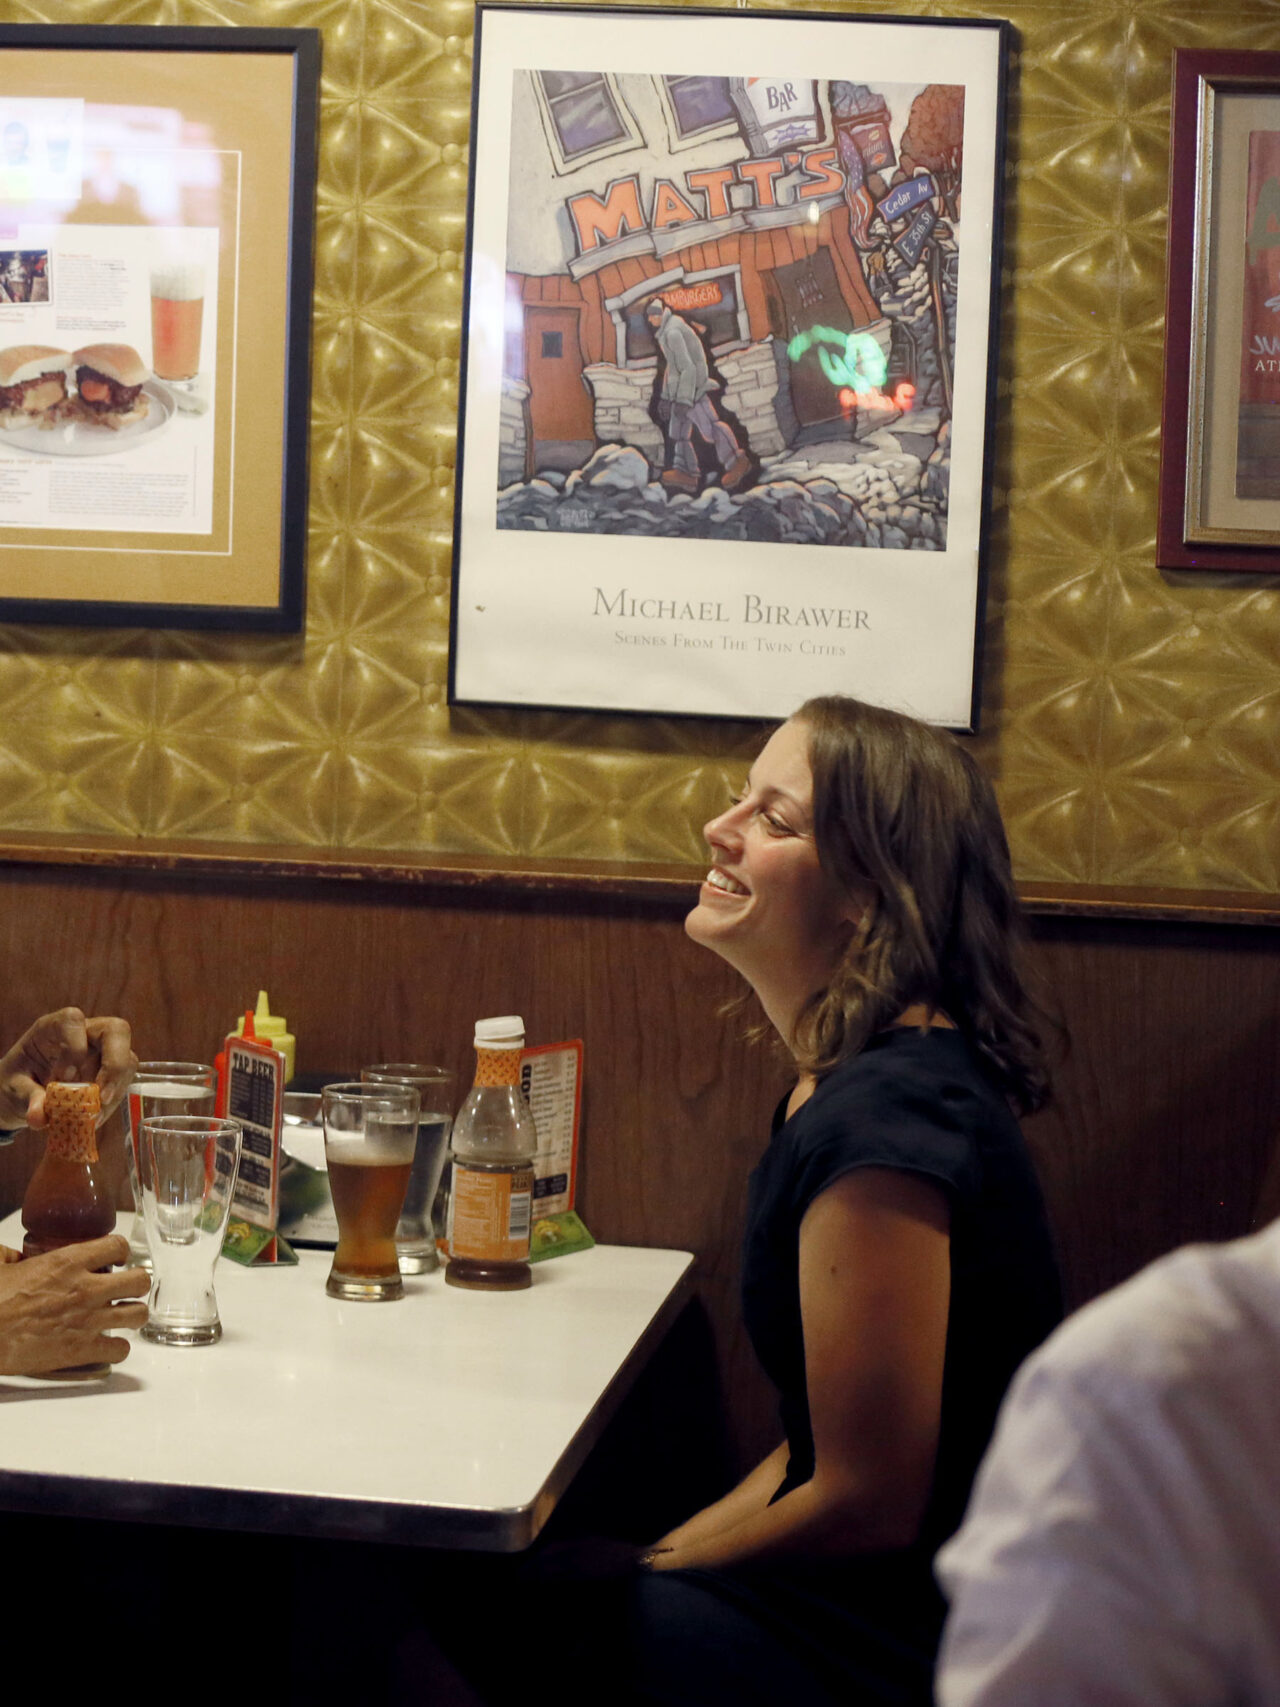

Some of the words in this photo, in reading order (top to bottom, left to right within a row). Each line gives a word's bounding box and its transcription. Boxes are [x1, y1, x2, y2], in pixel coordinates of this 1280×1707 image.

[766, 82, 798, 112] BAR
[567, 149, 847, 253] MATT'S
[885, 191, 910, 214] Cedar
[659, 284, 719, 309] AMBURGERS
[592, 586, 730, 622] MICHAEL
[744, 594, 872, 631] BIRAWER
[673, 632, 714, 649] FROM
[719, 635, 748, 651] THE
[753, 637, 793, 653] TWIN
[800, 639, 847, 657] CITIES
[233, 1052, 250, 1072] TAP
[252, 1058, 274, 1080] BEER
